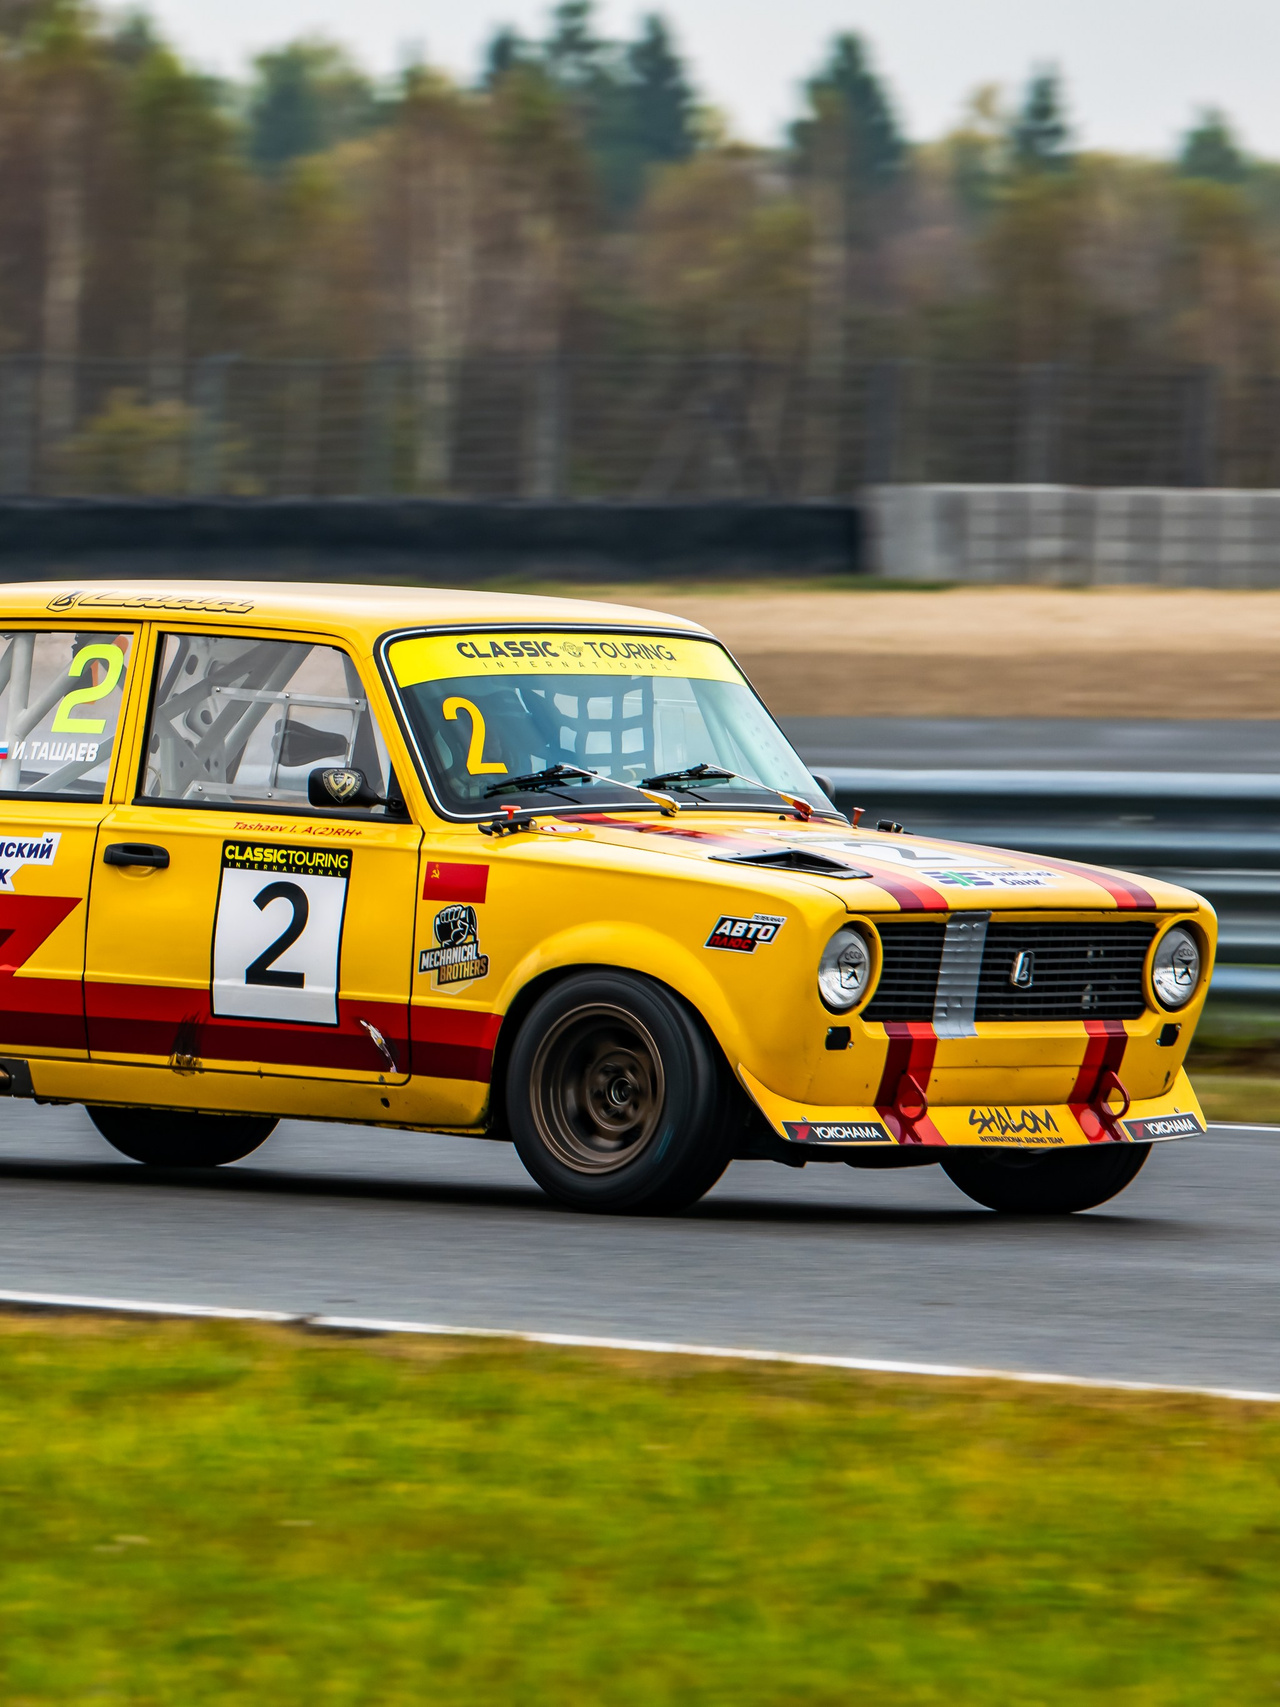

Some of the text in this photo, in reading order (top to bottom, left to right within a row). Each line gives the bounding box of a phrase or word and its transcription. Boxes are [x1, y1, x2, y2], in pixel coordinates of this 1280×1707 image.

[456, 641, 677, 662] CLASSIC TOURING
[483, 661, 672, 671] INTERNATIONAL
[51, 643, 125, 734] 2
[442, 696, 508, 776] 2
[11, 741, 100, 762] И.ТАШАЕВ
[233, 822, 287, 833] Tashaev
[301, 826, 363, 837] A(2)RH+
[224, 845, 349, 870] CLASSICTOURING
[228, 861, 342, 878] INTERNATIONAL
[245, 880, 310, 989] 2
[715, 919, 777, 941] АВТО
[709, 935, 752, 950] ПЛЮС
[421, 943, 478, 971] MECHANICAL
[440, 957, 488, 983] BROTHERS
[968, 1105, 1060, 1135] SHALOM
[1144, 1118, 1197, 1136] YOKOHAMA
[811, 1126, 883, 1139] YOKOHAMA
[978, 1136, 1065, 1144] INTERNATIONAL RACING TEAM
